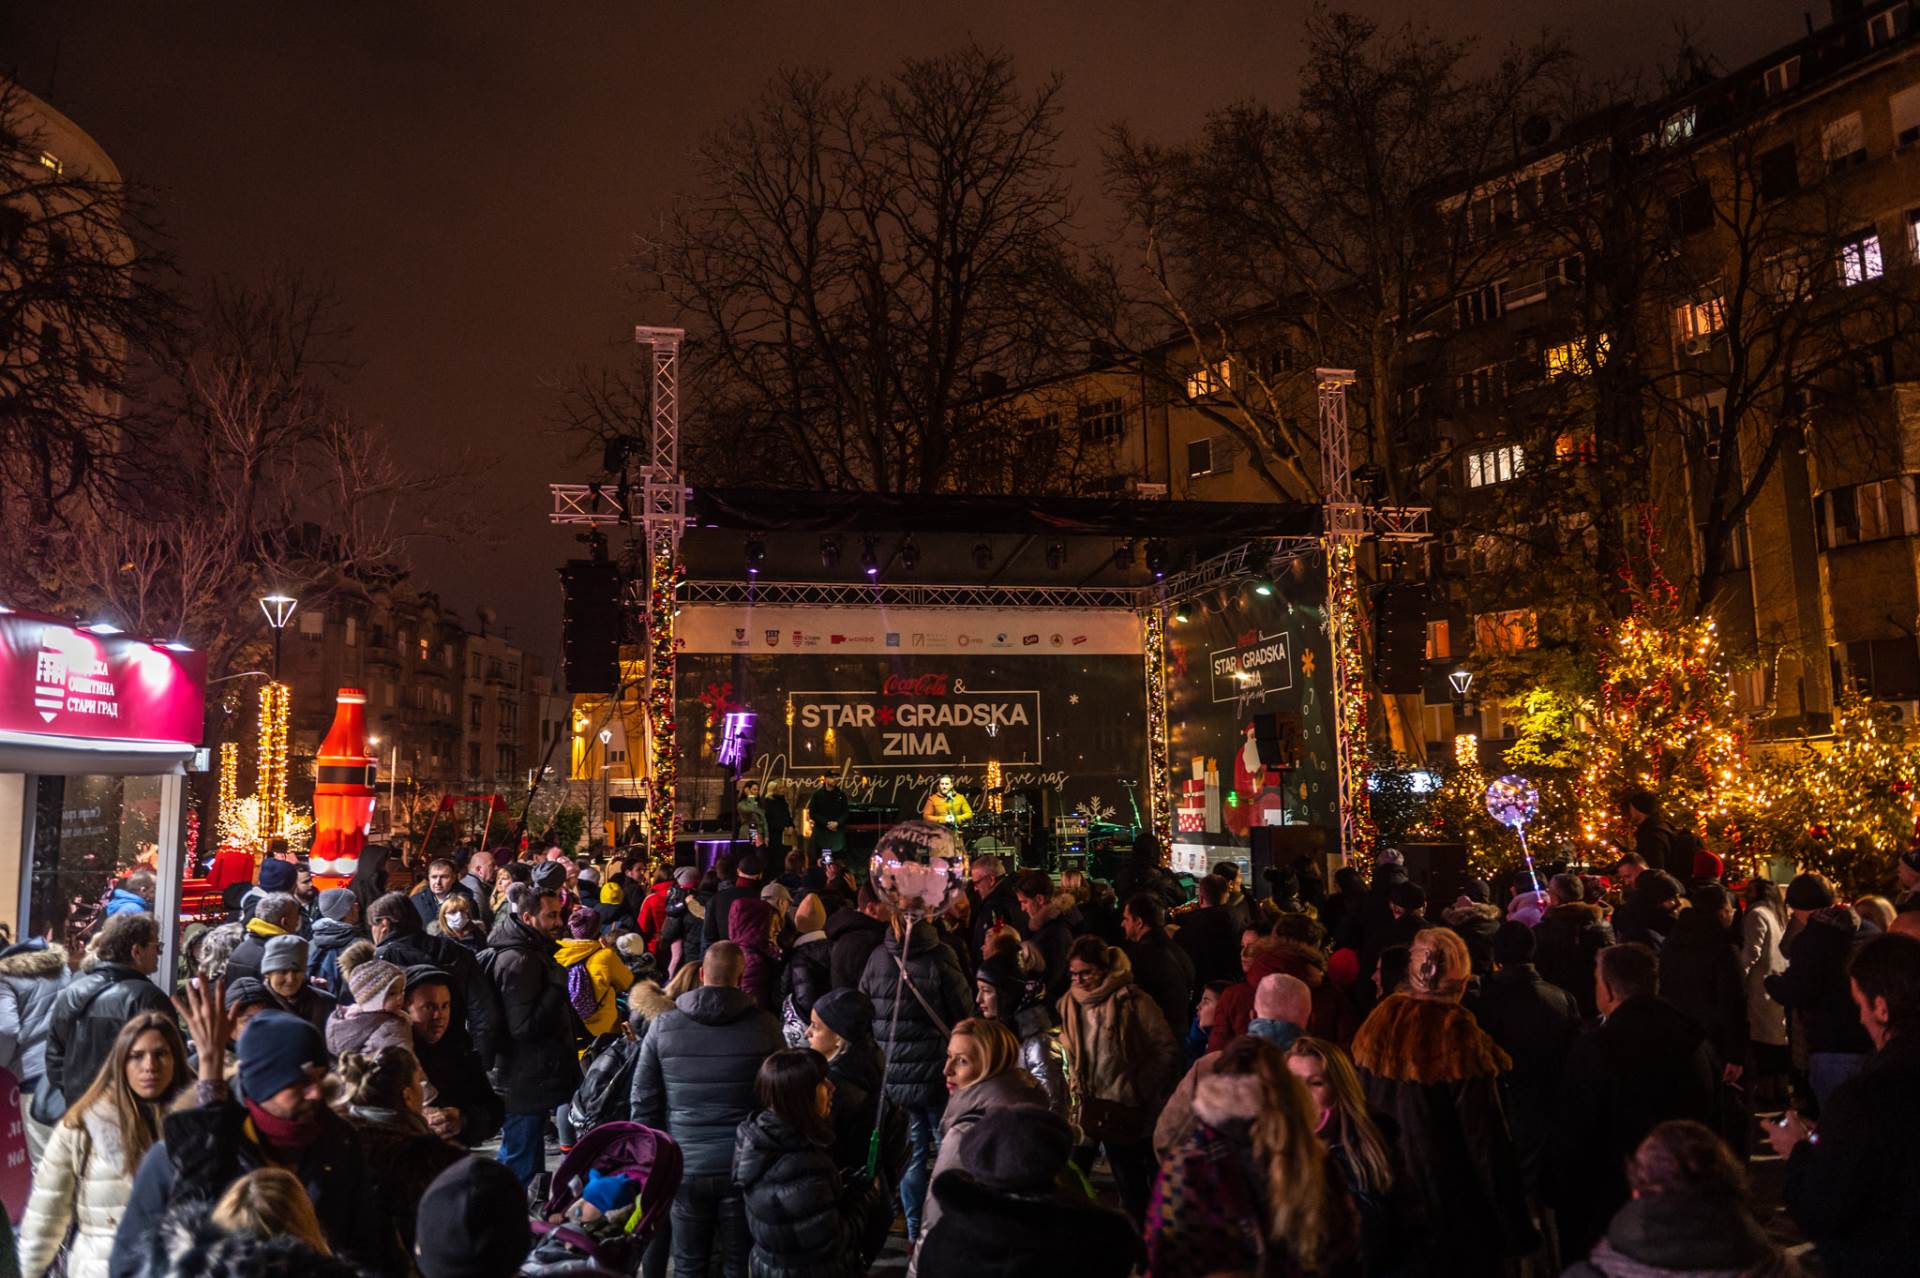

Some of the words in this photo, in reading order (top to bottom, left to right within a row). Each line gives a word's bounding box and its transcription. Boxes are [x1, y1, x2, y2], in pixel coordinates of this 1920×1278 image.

[1214, 656, 1237, 675] STAR
[1242, 642, 1286, 669] GRADSKA
[953, 679, 966, 694] &
[1240, 670, 1262, 690] ZMA
[67, 697, 97, 714] СТАРИ
[97, 700, 118, 718] ГРАД
[801, 704, 876, 728] STAR
[896, 703, 1029, 727] GRADSKA
[882, 732, 951, 756] ZIMA
[756, 752, 889, 806] Novodišnji
[890, 769, 973, 813] progm
